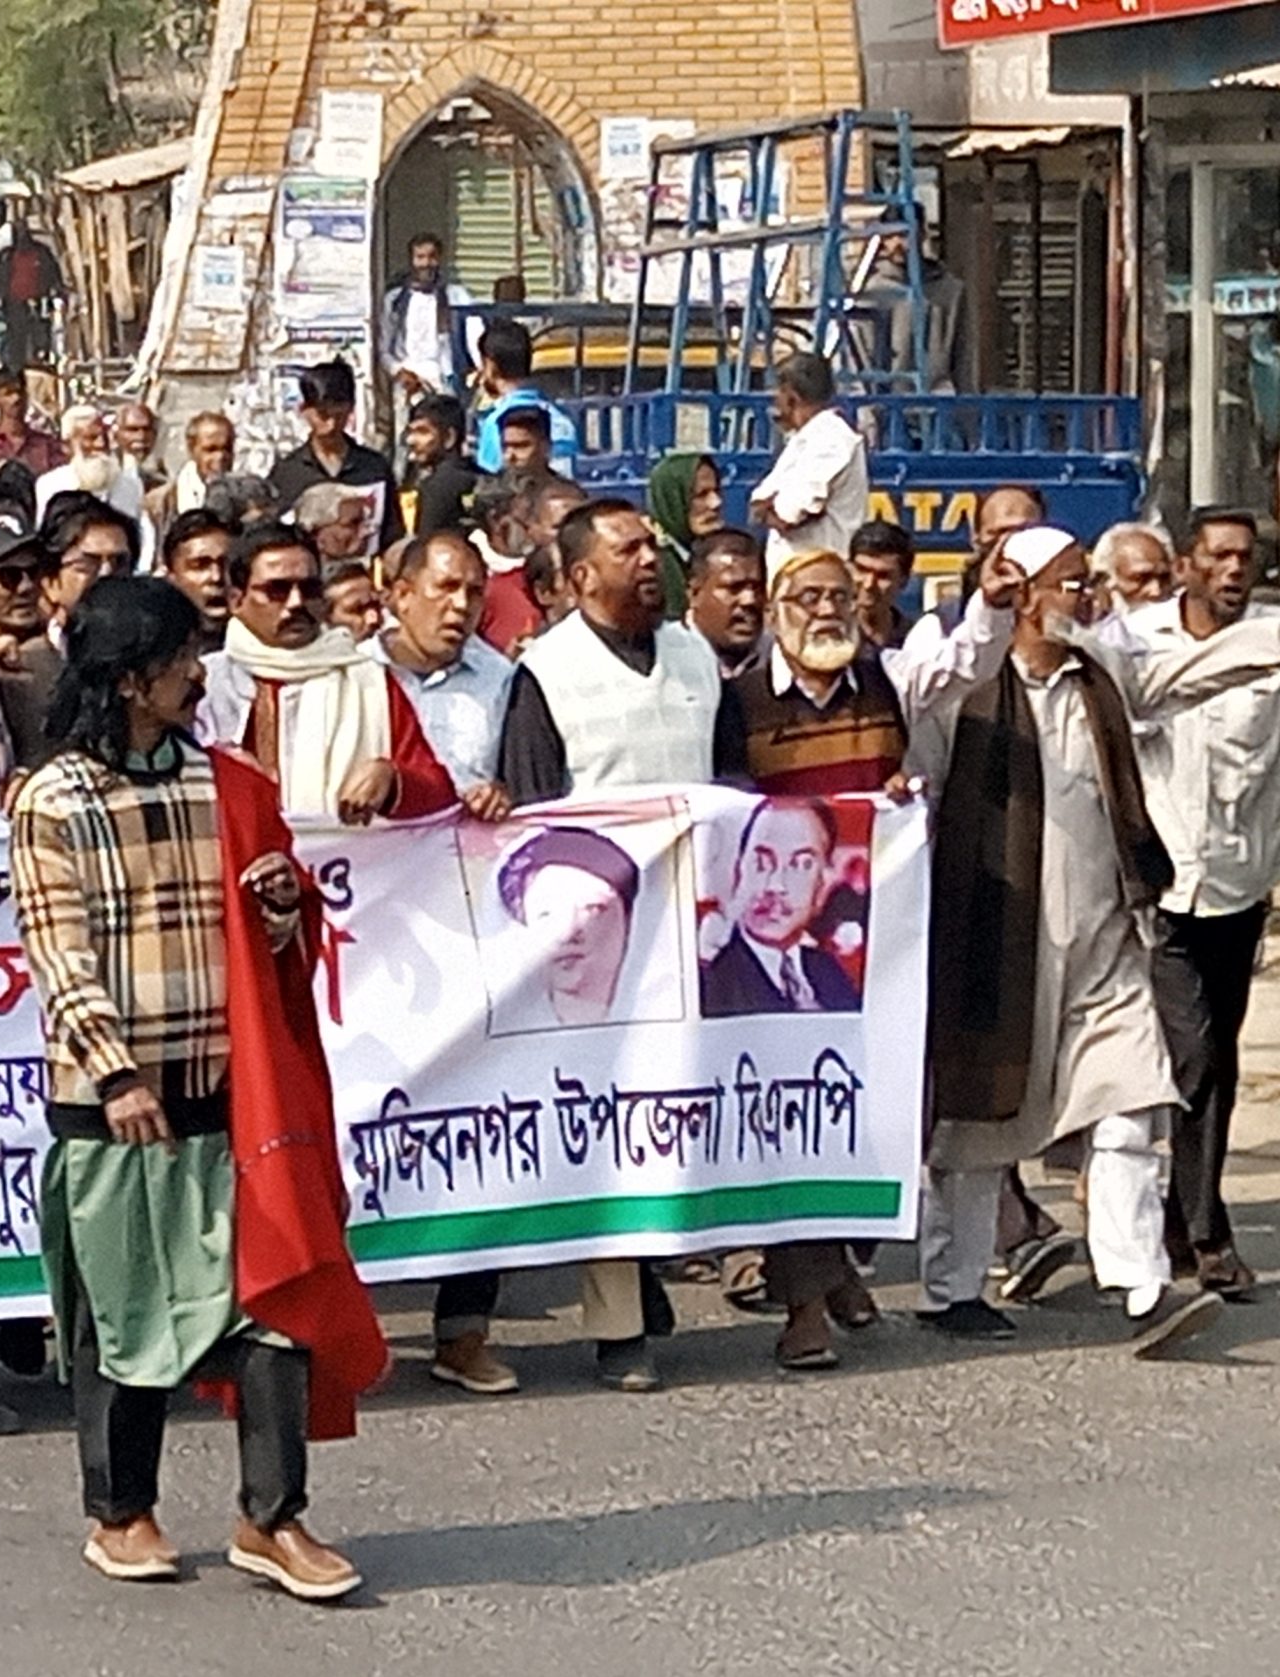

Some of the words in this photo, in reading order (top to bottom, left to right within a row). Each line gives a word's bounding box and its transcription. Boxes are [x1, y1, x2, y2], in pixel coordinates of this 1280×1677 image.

[868, 491, 977, 533] ATA
[553, 1066, 726, 1170] উপজেলা
[734, 1048, 863, 1163] বিএনপি
